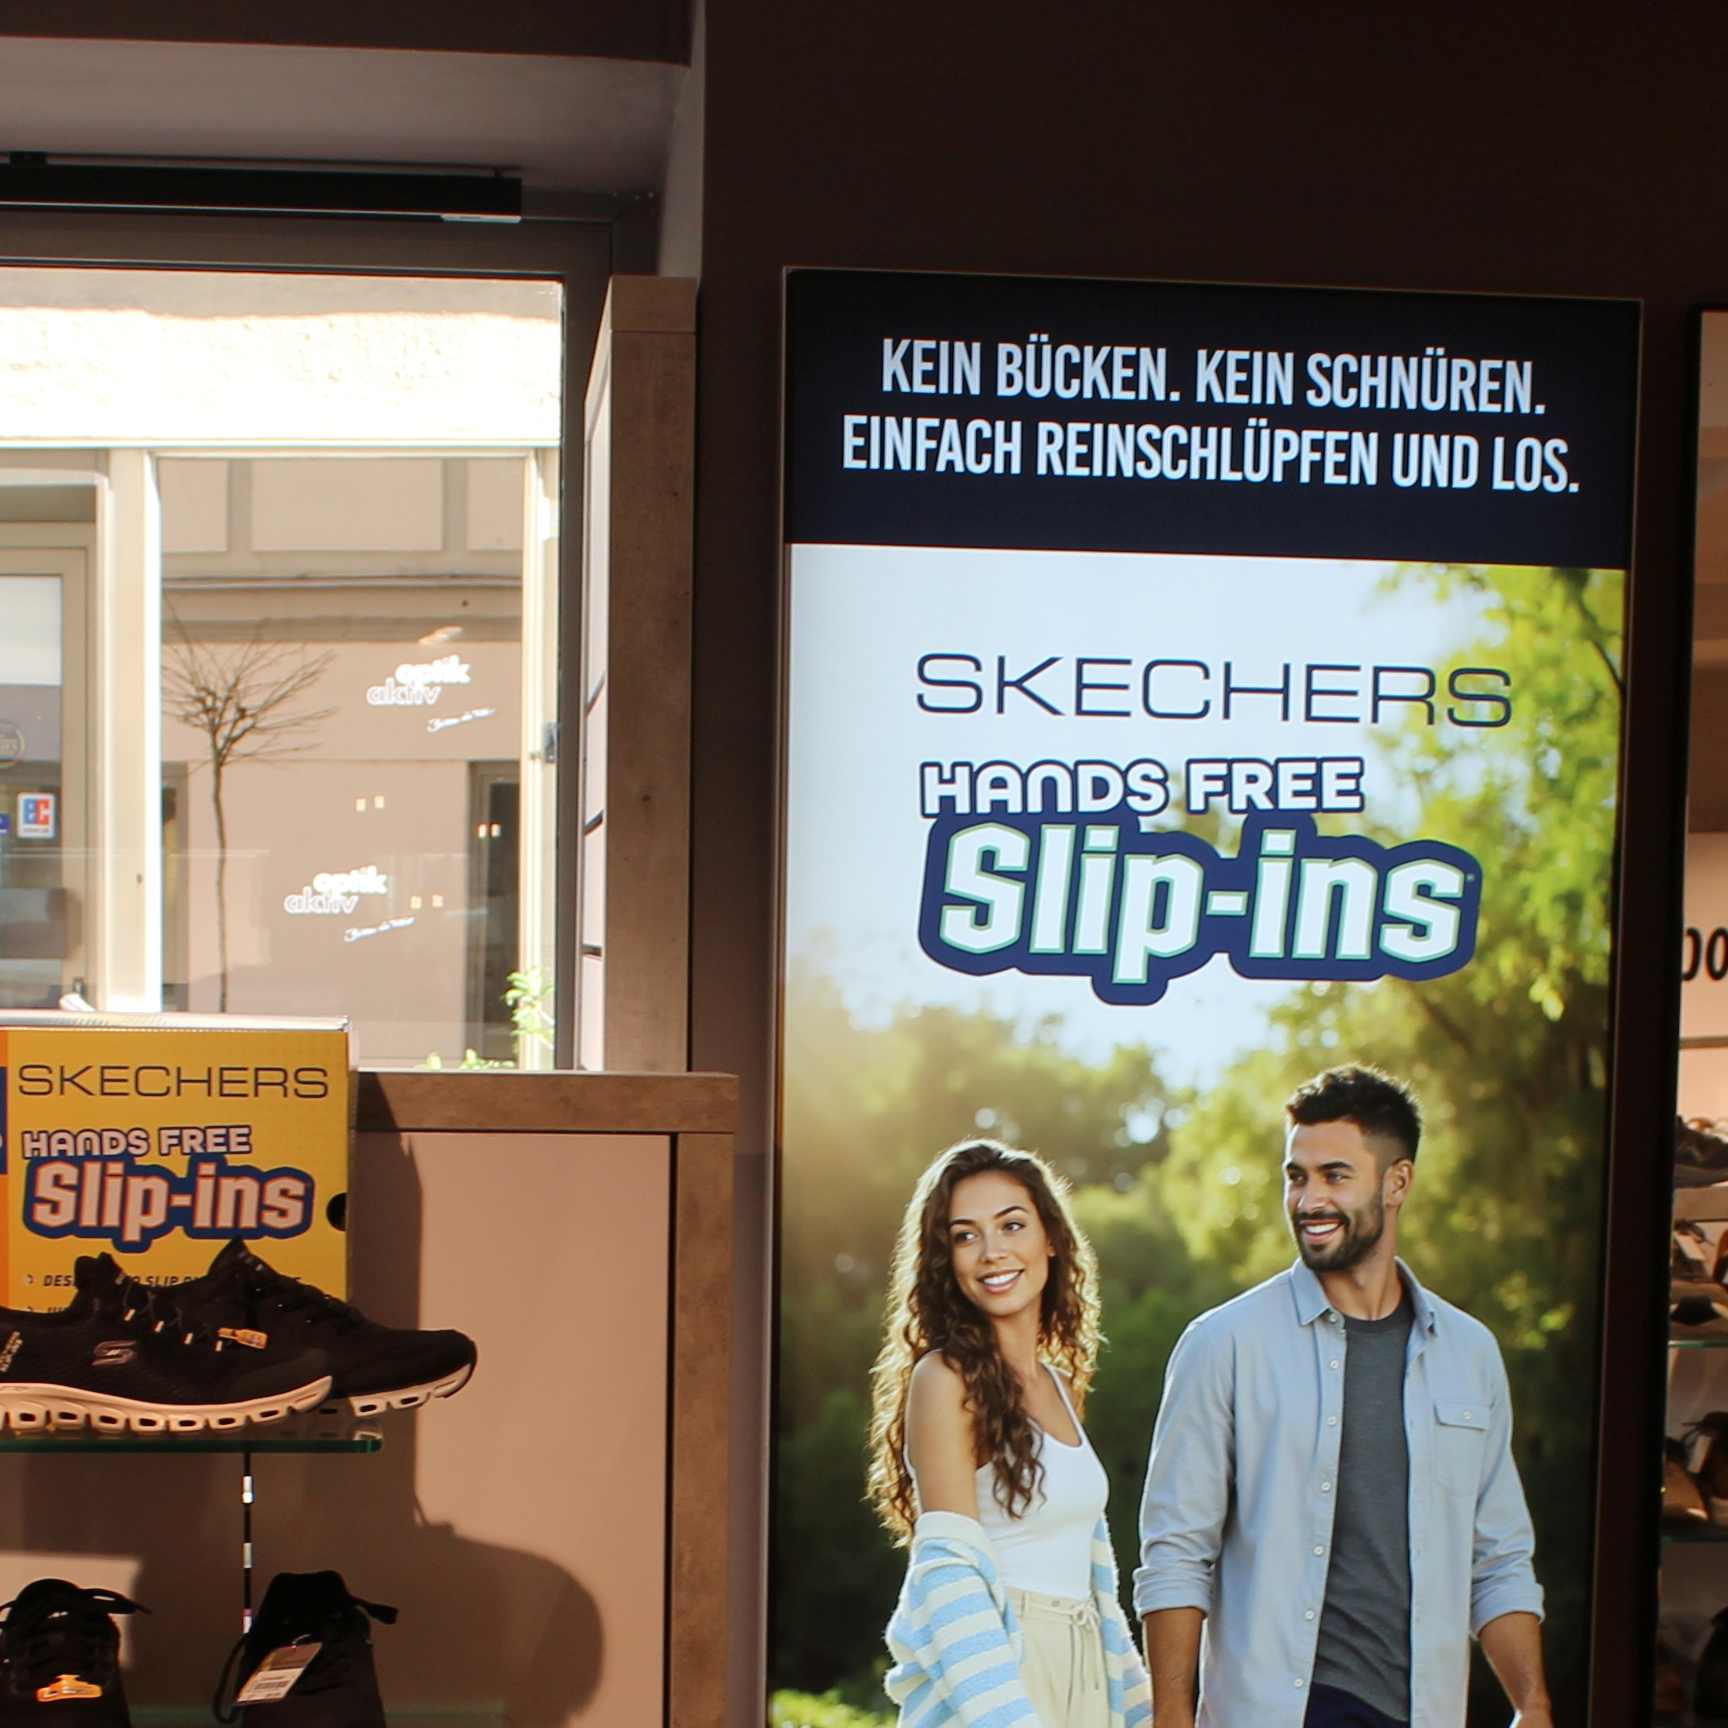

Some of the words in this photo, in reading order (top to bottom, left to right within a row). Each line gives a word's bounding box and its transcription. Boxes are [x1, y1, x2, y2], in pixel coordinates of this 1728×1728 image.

[882, 337, 981, 395] KEIN
[996, 333, 1180, 402] BÜCKEN.
[1196, 348, 1294, 406] KEIN
[1306, 346, 1546, 415] SCHNÜREN.
[842, 414, 1022, 475] EINFACH
[1036, 417, 1379, 486] REINSCHLÜPFEN
[1392, 432, 1480, 488] UND
[1492, 436, 1580, 493] LOS.
[915, 652, 1513, 728] SKECHERS
[920, 761, 1169, 817] HANDS
[1186, 757, 1365, 813] FREE
[934, 818, 1470, 987] Slip-ins
[18, 1064, 329, 1099] SKECHERS
[23, 1127, 150, 1158] HANDS
[159, 1125, 252, 1156] FREE
[28, 1157, 315, 1248] Slip-ins
